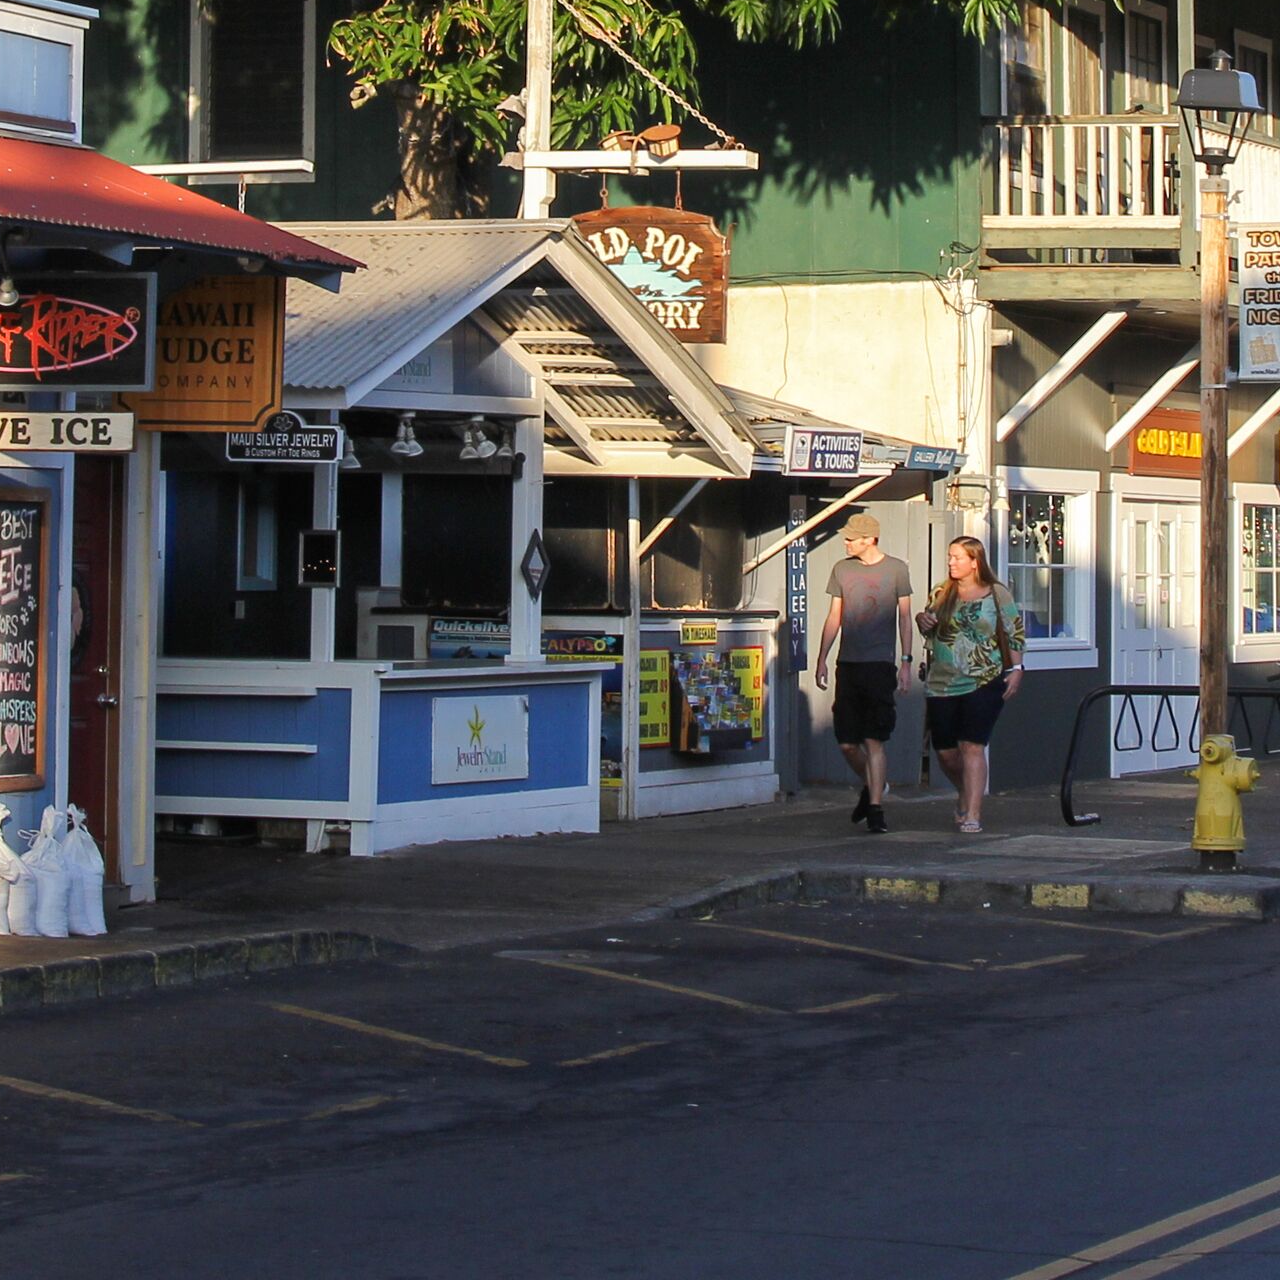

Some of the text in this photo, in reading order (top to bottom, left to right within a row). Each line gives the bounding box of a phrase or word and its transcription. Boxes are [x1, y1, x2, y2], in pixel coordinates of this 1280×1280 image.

[586, 227, 704, 275] LD POI
[161, 337, 255, 364] UDGE
[159, 375, 253, 388] OMPANY
[50, 418, 112, 445] ICE
[230, 432, 335, 447] MAUI SILVER JEWELRY
[812, 435, 860, 452] ACTIVITIES
[1169, 430, 1202, 458] ISLA
[814, 453, 855, 469] & TOURS
[1, 509, 37, 540] BEST
[433, 620, 509, 633] Quicksilve
